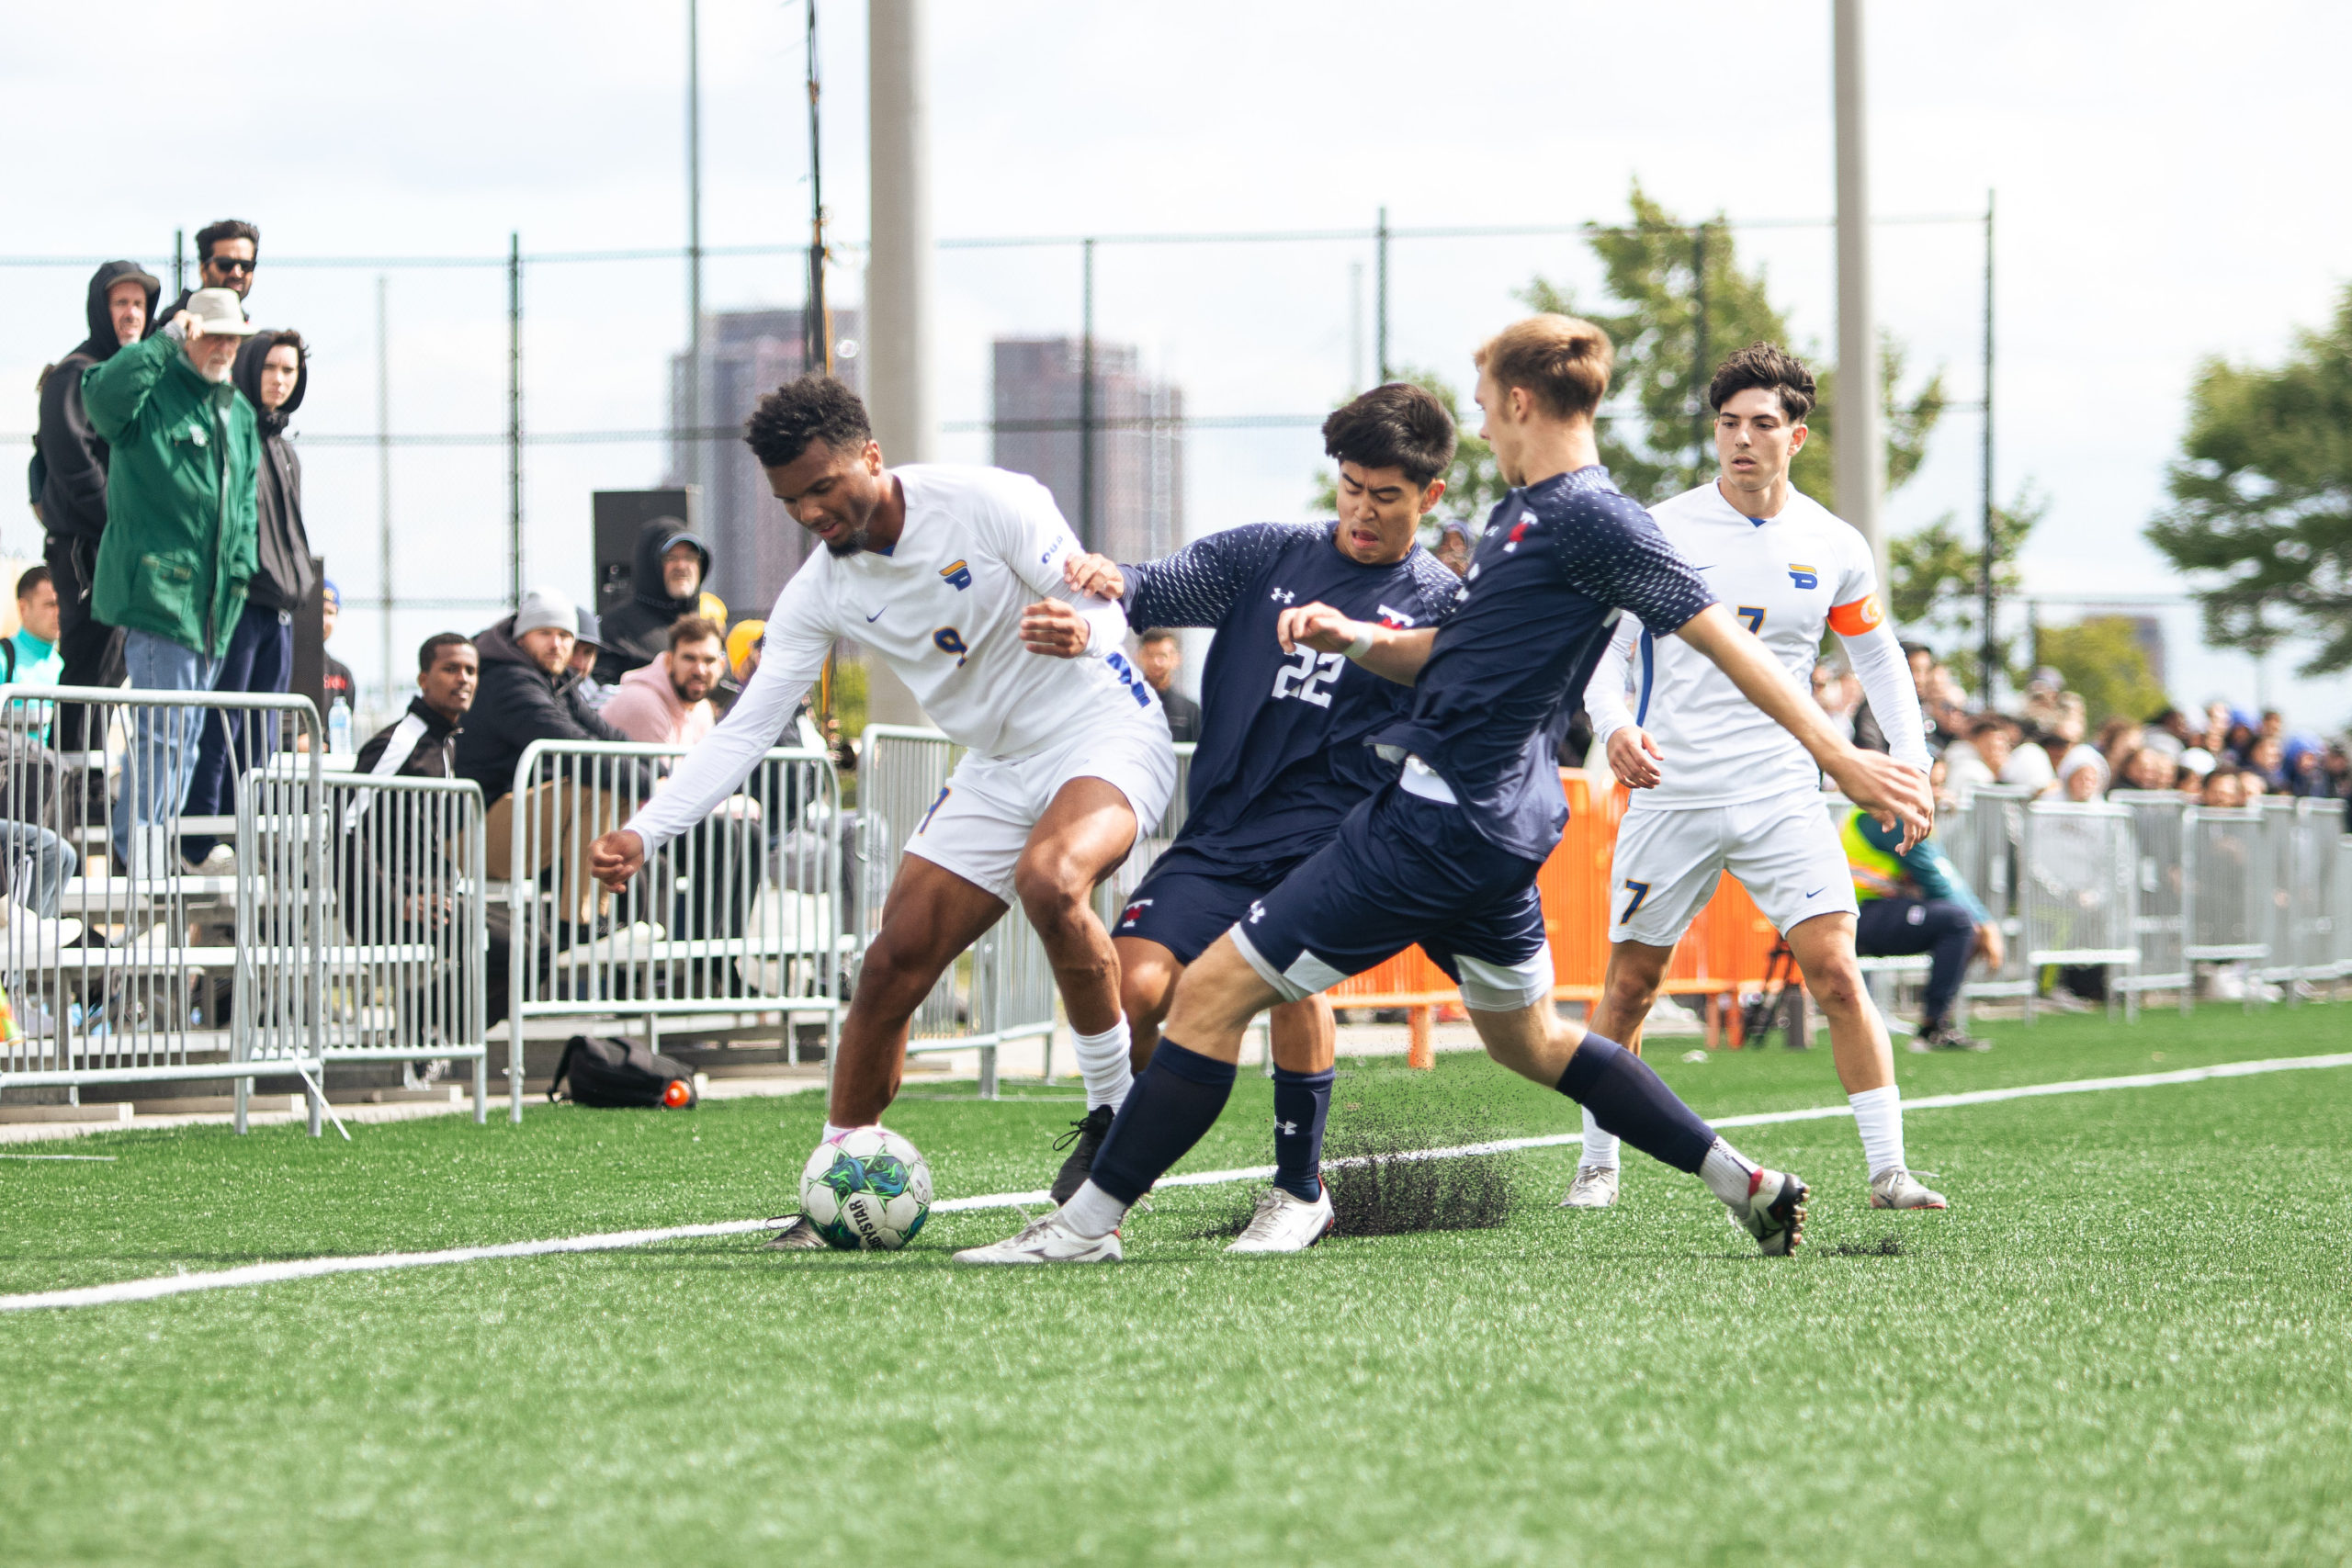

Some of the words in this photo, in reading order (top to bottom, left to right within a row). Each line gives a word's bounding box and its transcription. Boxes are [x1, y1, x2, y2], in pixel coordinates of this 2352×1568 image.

[1736, 604, 1767, 636] 7
[933, 626, 968, 669] 9
[1272, 642, 1347, 709] 22
[1619, 878, 1652, 926] 7
